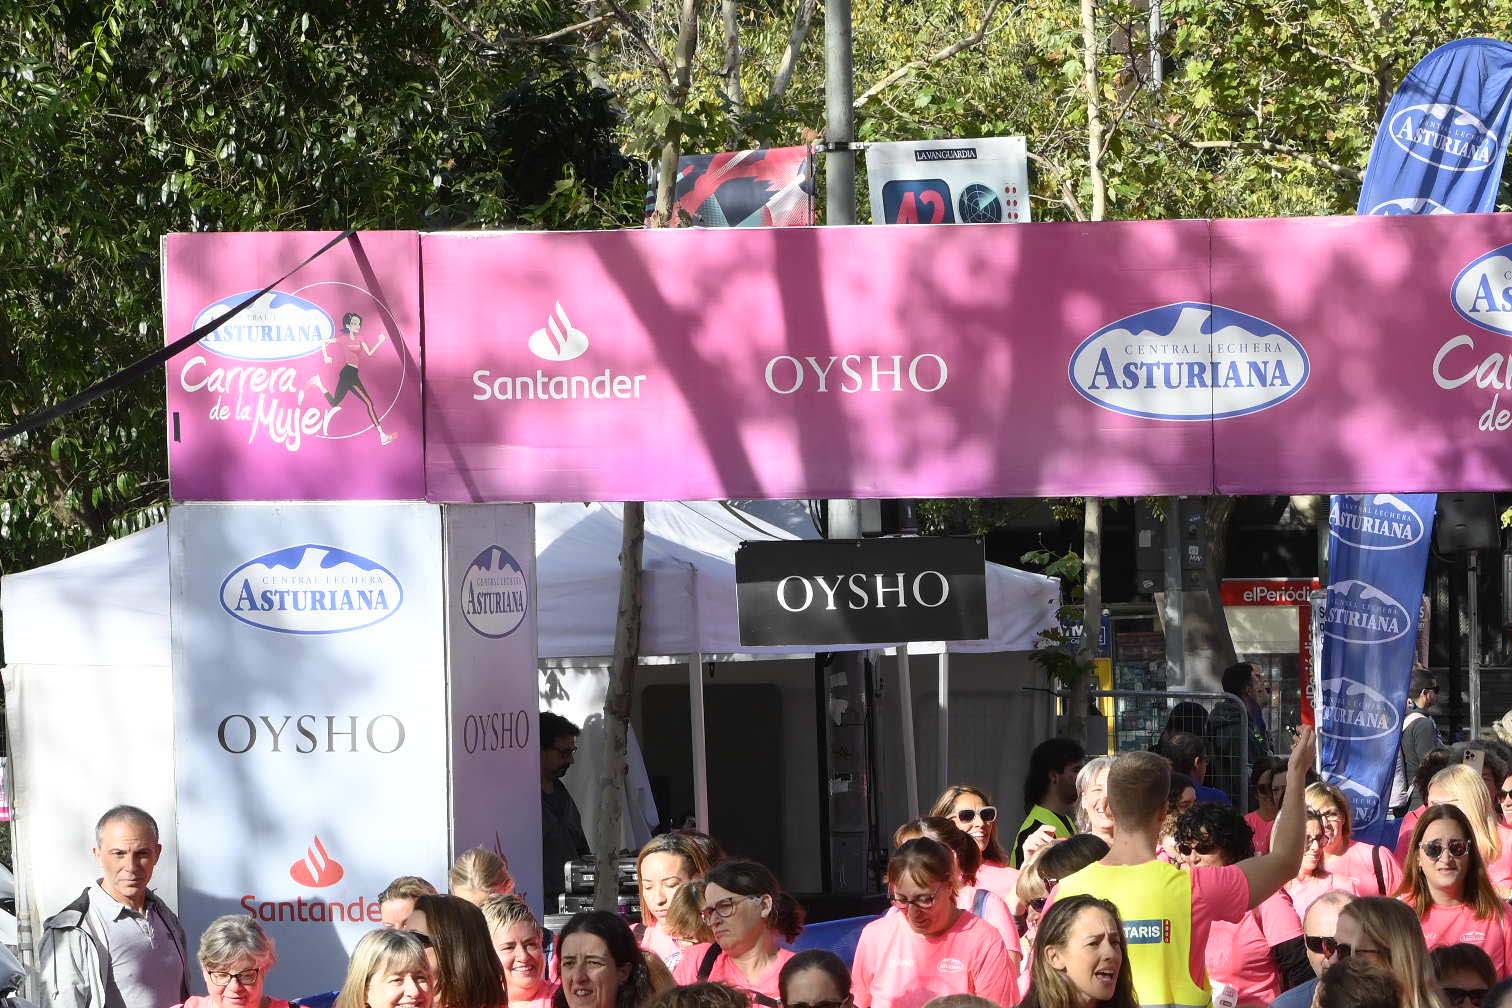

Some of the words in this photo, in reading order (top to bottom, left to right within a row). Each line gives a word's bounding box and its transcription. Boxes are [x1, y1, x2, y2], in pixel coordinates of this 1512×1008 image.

[1124, 342, 1199, 355] CENTRAL
[1207, 342, 1282, 354] LECHERA
[180, 356, 298, 394] Carrera
[473, 368, 646, 401] Santander
[763, 353, 949, 395] OYSHO
[1089, 347, 1291, 391] ASTURIANA
[209, 402, 231, 424] de
[235, 397, 252, 422] la
[249, 394, 343, 452] Mujer
[1478, 393, 1511, 433] de
[1329, 501, 1413, 541] ASTURIANA
[233, 578, 390, 612] ASTURIANA
[261, 575, 321, 585] CENTRAL
[325, 575, 384, 585] LECHERA
[467, 581, 524, 615] ASTURIANA
[776, 570, 950, 613] OYSHO
[217, 713, 406, 754] OYSHO
[464, 709, 530, 754] OYSHO
[240, 894, 382, 923] Santande
[1124, 926, 1160, 938] TARIS
